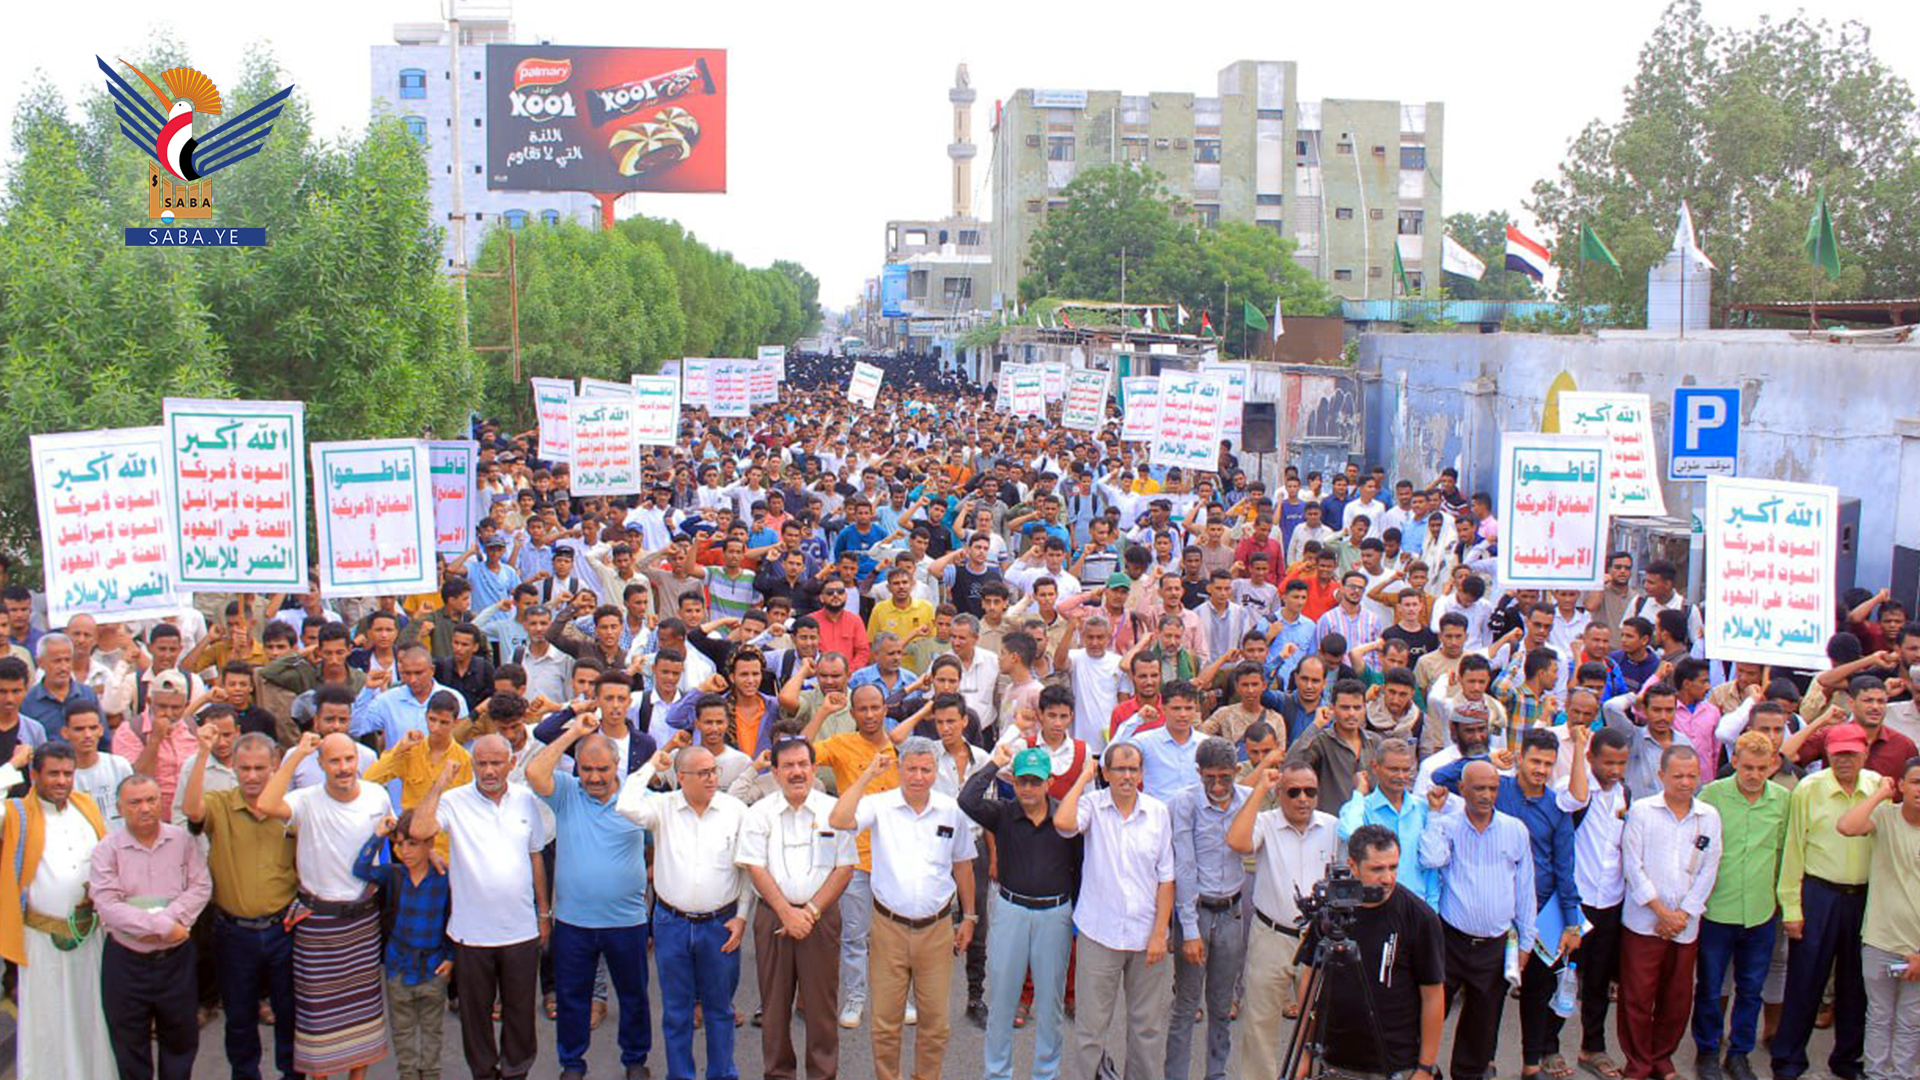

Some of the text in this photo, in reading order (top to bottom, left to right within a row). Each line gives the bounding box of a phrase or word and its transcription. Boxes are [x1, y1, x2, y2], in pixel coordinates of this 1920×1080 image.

[520, 66, 567, 82] palmary
[509, 91, 577, 117] KOOL
[601, 80, 658, 111] KOOL
[507, 146, 583, 168] التي لا تقاوم
[1573, 403, 1641, 427] الله أكبر
[1686, 395, 1727, 449] P
[179, 419, 288, 457] الله أكبر
[53, 450, 157, 491] الله أكبر
[180, 458, 289, 484] الموت لأمريكا
[329, 458, 411, 489] قاطعوا
[430, 457, 466, 474] قاط
[1517, 460, 1595, 486] قاطعوا
[54, 490, 160, 516] الموت لأمريكا
[182, 488, 291, 513] الموت لإسرائيل
[331, 491, 413, 519] البضائع الأمريكية
[1515, 492, 1593, 517] البضائع الأمريكية
[1621, 485, 1650, 504] النصر
[1724, 495, 1821, 528] الله أكبر
[58, 517, 164, 547] الموت لإسرائيل
[183, 519, 291, 541] اللعنة على اليهود
[369, 522, 376, 541] و
[1548, 522, 1555, 538] و
[1514, 546, 1591, 569] الإسرائيلية
[1723, 532, 1820, 558] الموت لأمريكا
[60, 544, 167, 574] اللعنة على اليهود
[185, 543, 292, 577] النصر للإسلام
[335, 547, 416, 573] الإسرائيلية
[1722, 560, 1820, 585] الموت لإسرائيل
[63, 571, 170, 609] النصر للإسلام
[1723, 589, 1820, 611] اللعنة على اليهود
[1723, 614, 1821, 647] النصر للإسلام
